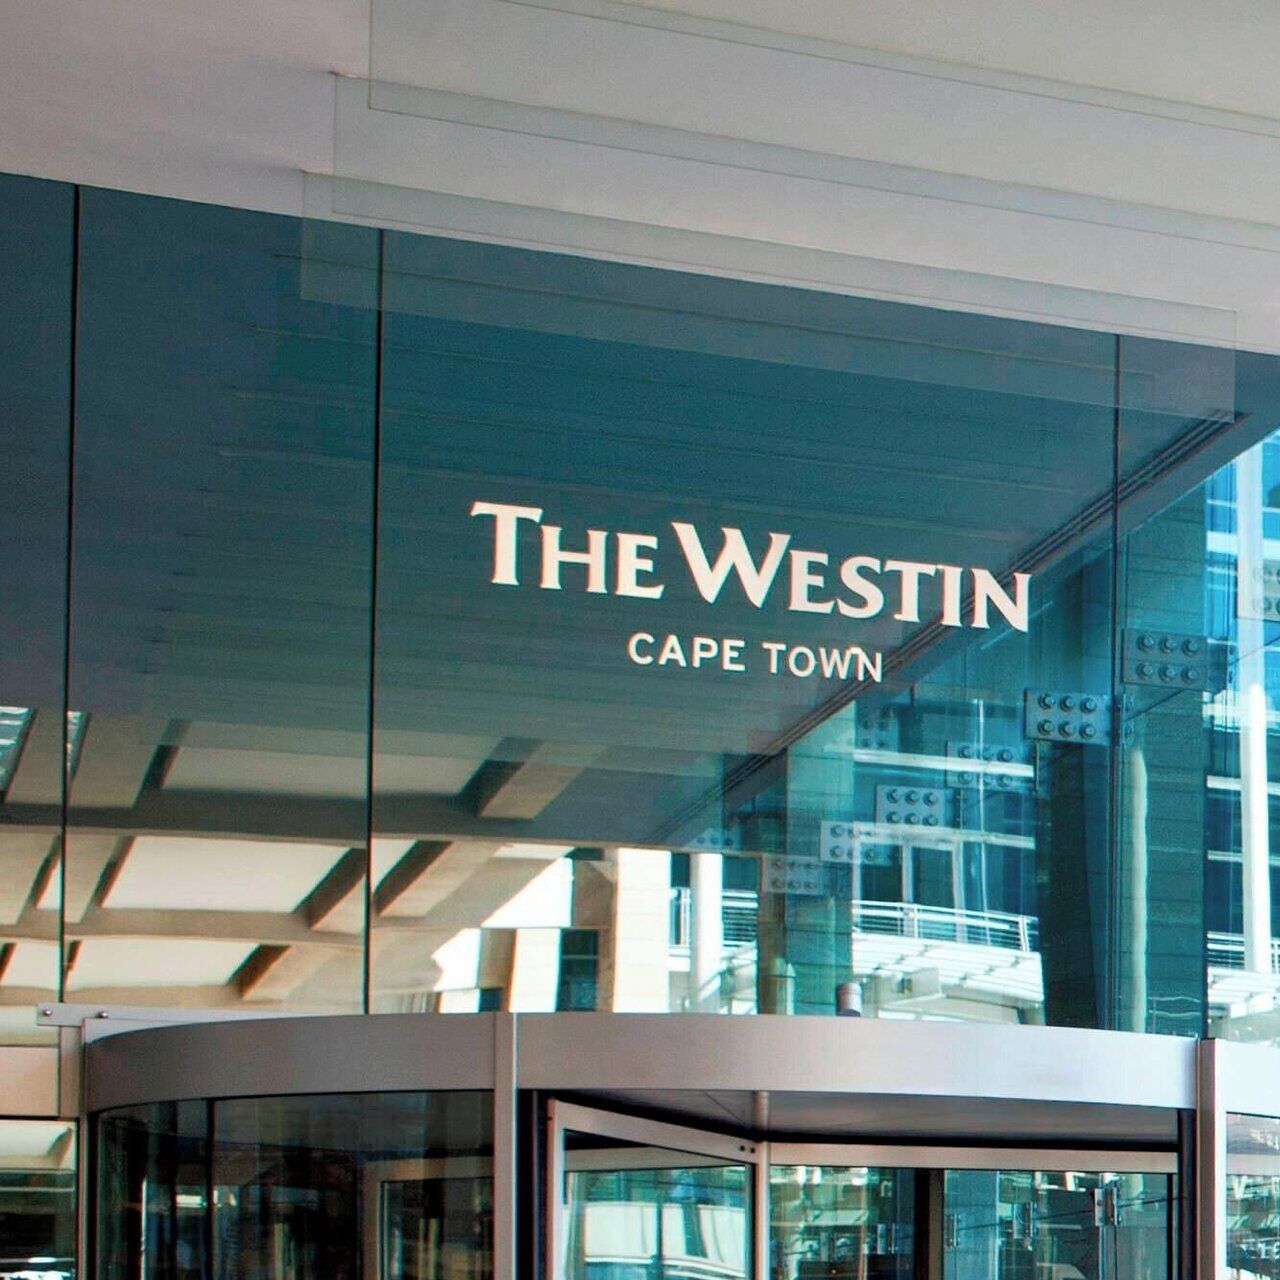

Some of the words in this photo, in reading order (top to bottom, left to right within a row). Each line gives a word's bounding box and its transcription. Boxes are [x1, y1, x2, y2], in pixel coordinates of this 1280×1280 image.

[470, 501, 664, 599] THE
[671, 521, 1032, 632] WESTIN
[628, 632, 746, 673] CAPE
[762, 642, 884, 683] TOWN
